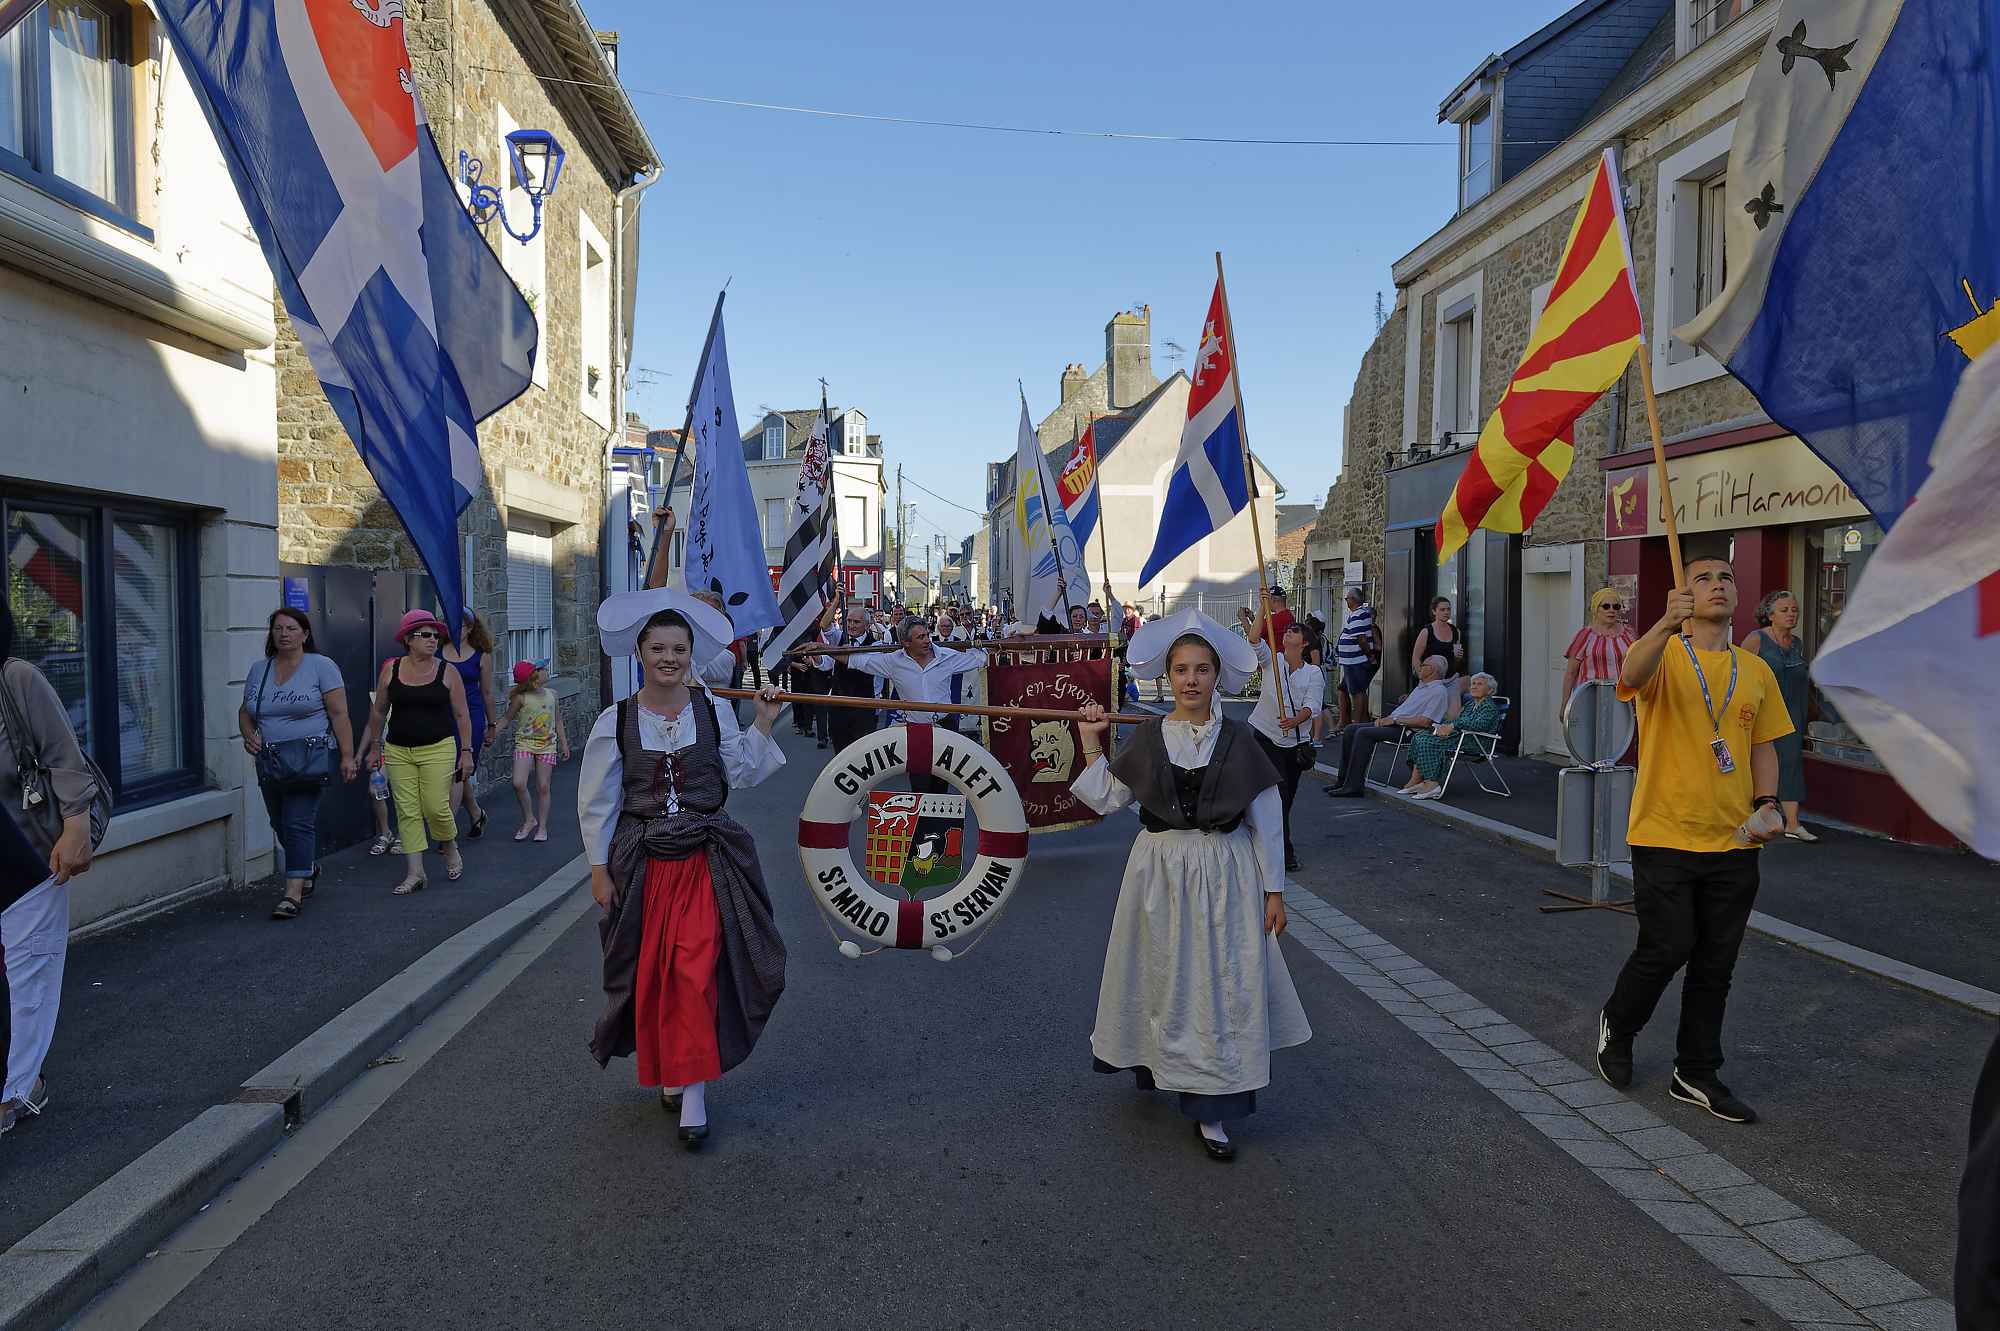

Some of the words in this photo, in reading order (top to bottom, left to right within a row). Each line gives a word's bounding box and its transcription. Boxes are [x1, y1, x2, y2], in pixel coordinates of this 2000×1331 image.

[834, 741, 905, 796] GWIK
[935, 745, 1003, 800] ALET
[830, 886, 890, 937] MALO
[953, 860, 1013, 926] SERVAN
